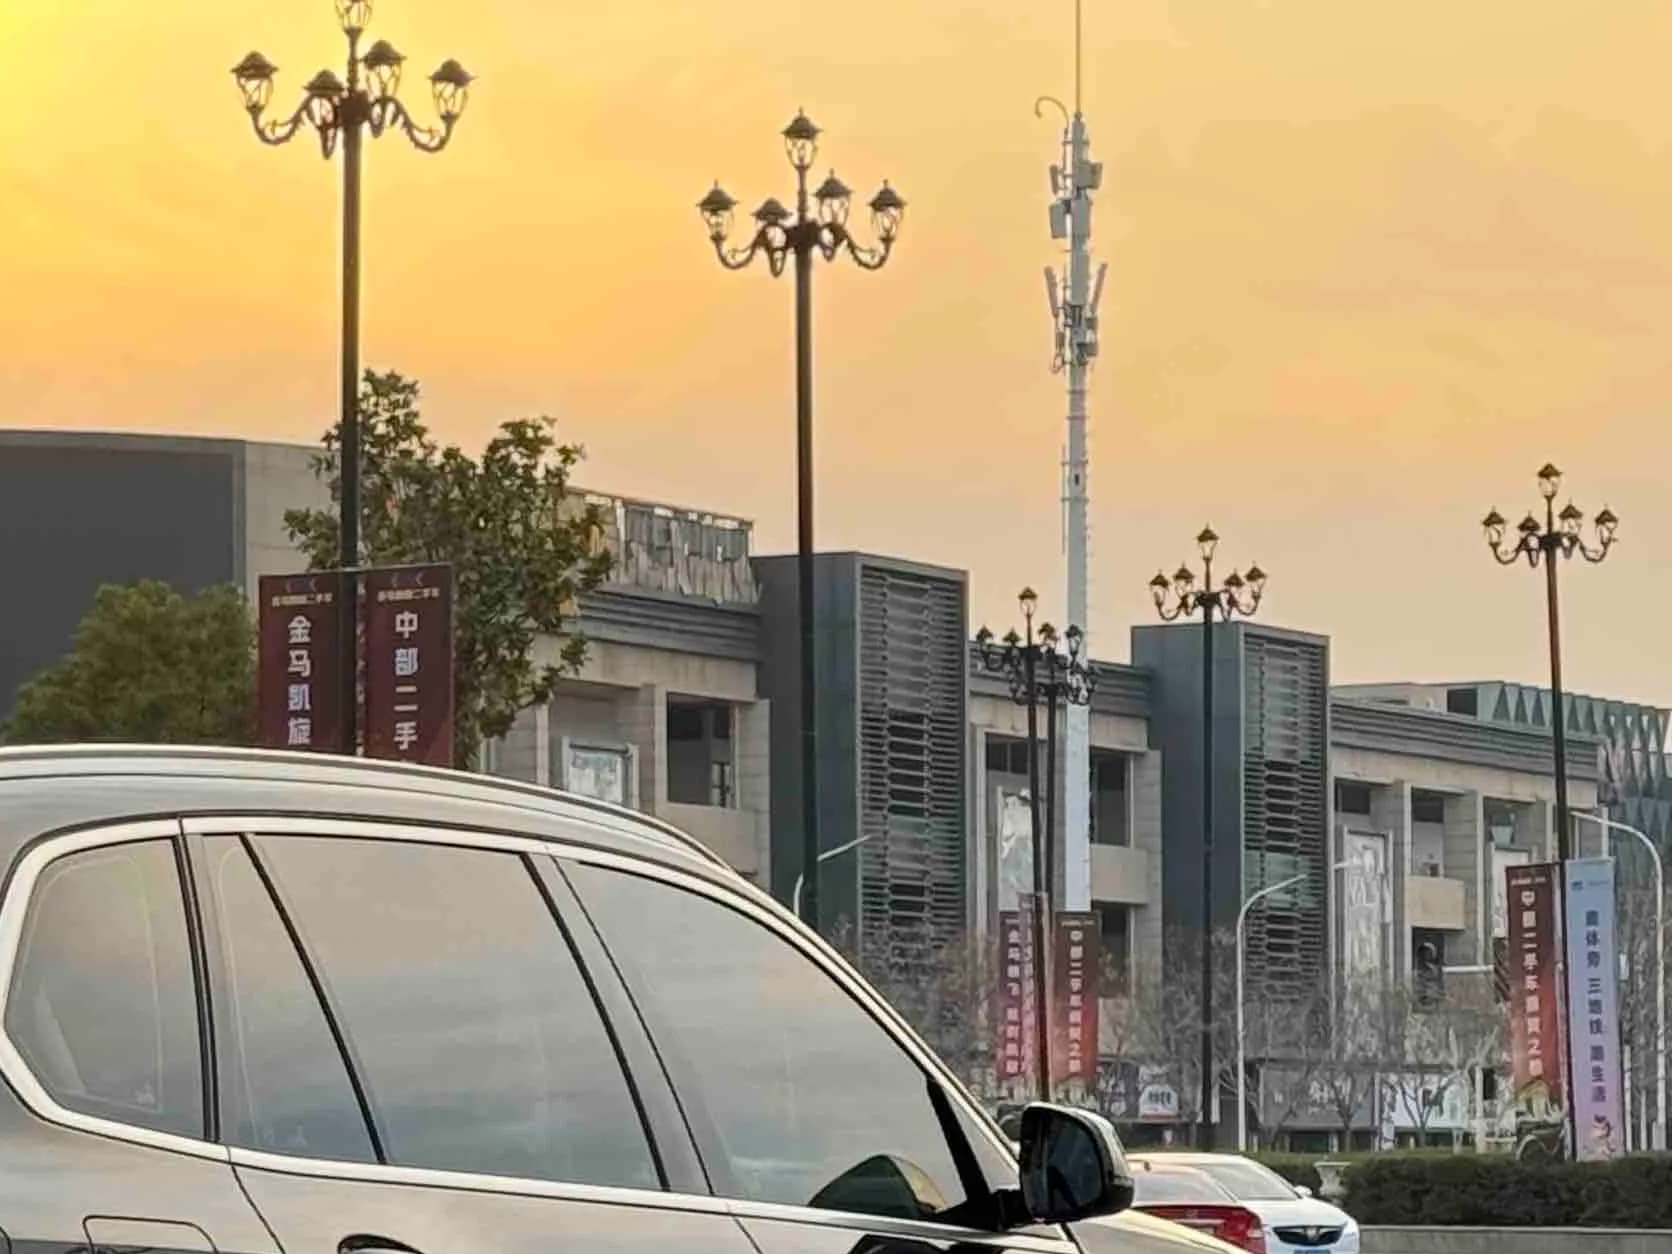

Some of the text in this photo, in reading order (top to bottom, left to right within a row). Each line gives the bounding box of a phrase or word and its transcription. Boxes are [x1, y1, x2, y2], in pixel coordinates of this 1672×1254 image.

[287, 615, 312, 746] 金马凯旋
[393, 610, 419, 750] 中部二手
